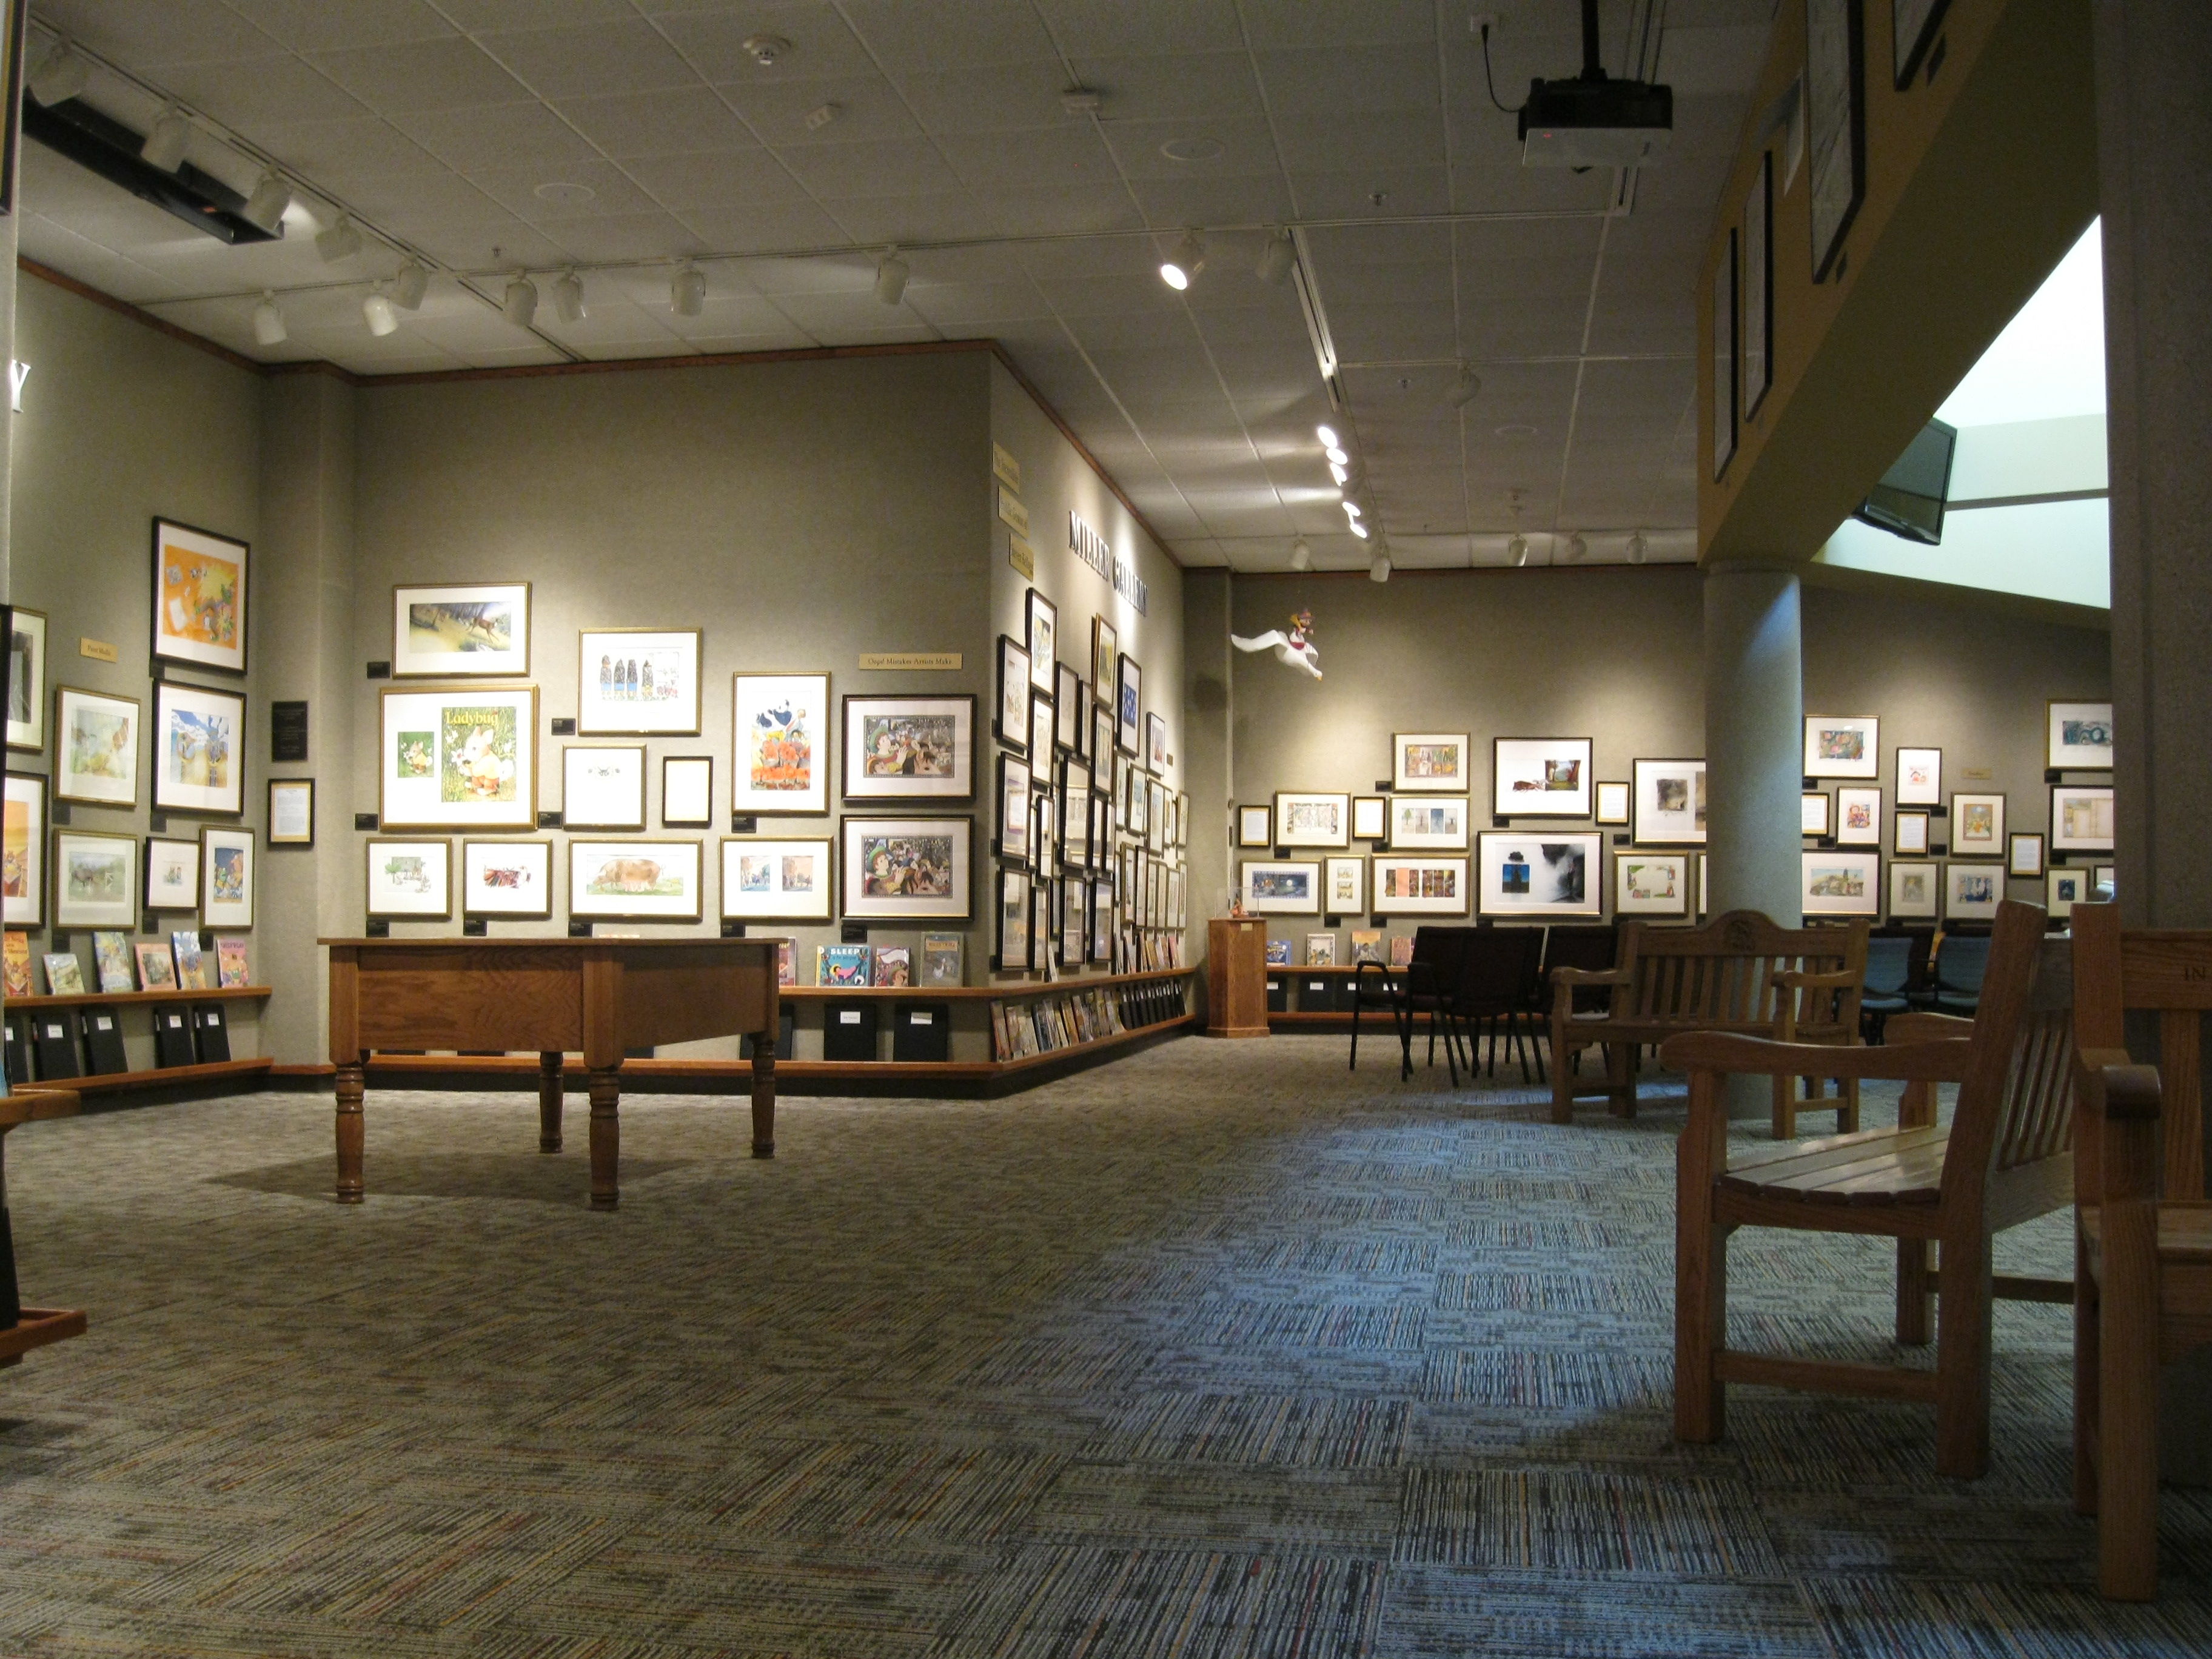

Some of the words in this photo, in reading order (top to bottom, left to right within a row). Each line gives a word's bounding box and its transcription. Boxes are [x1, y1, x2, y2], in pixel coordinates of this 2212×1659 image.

[1068, 510, 1110, 582] MILLER
[1112, 555, 1148, 617] GALLERY
[446, 711, 498, 726] Ladybug
